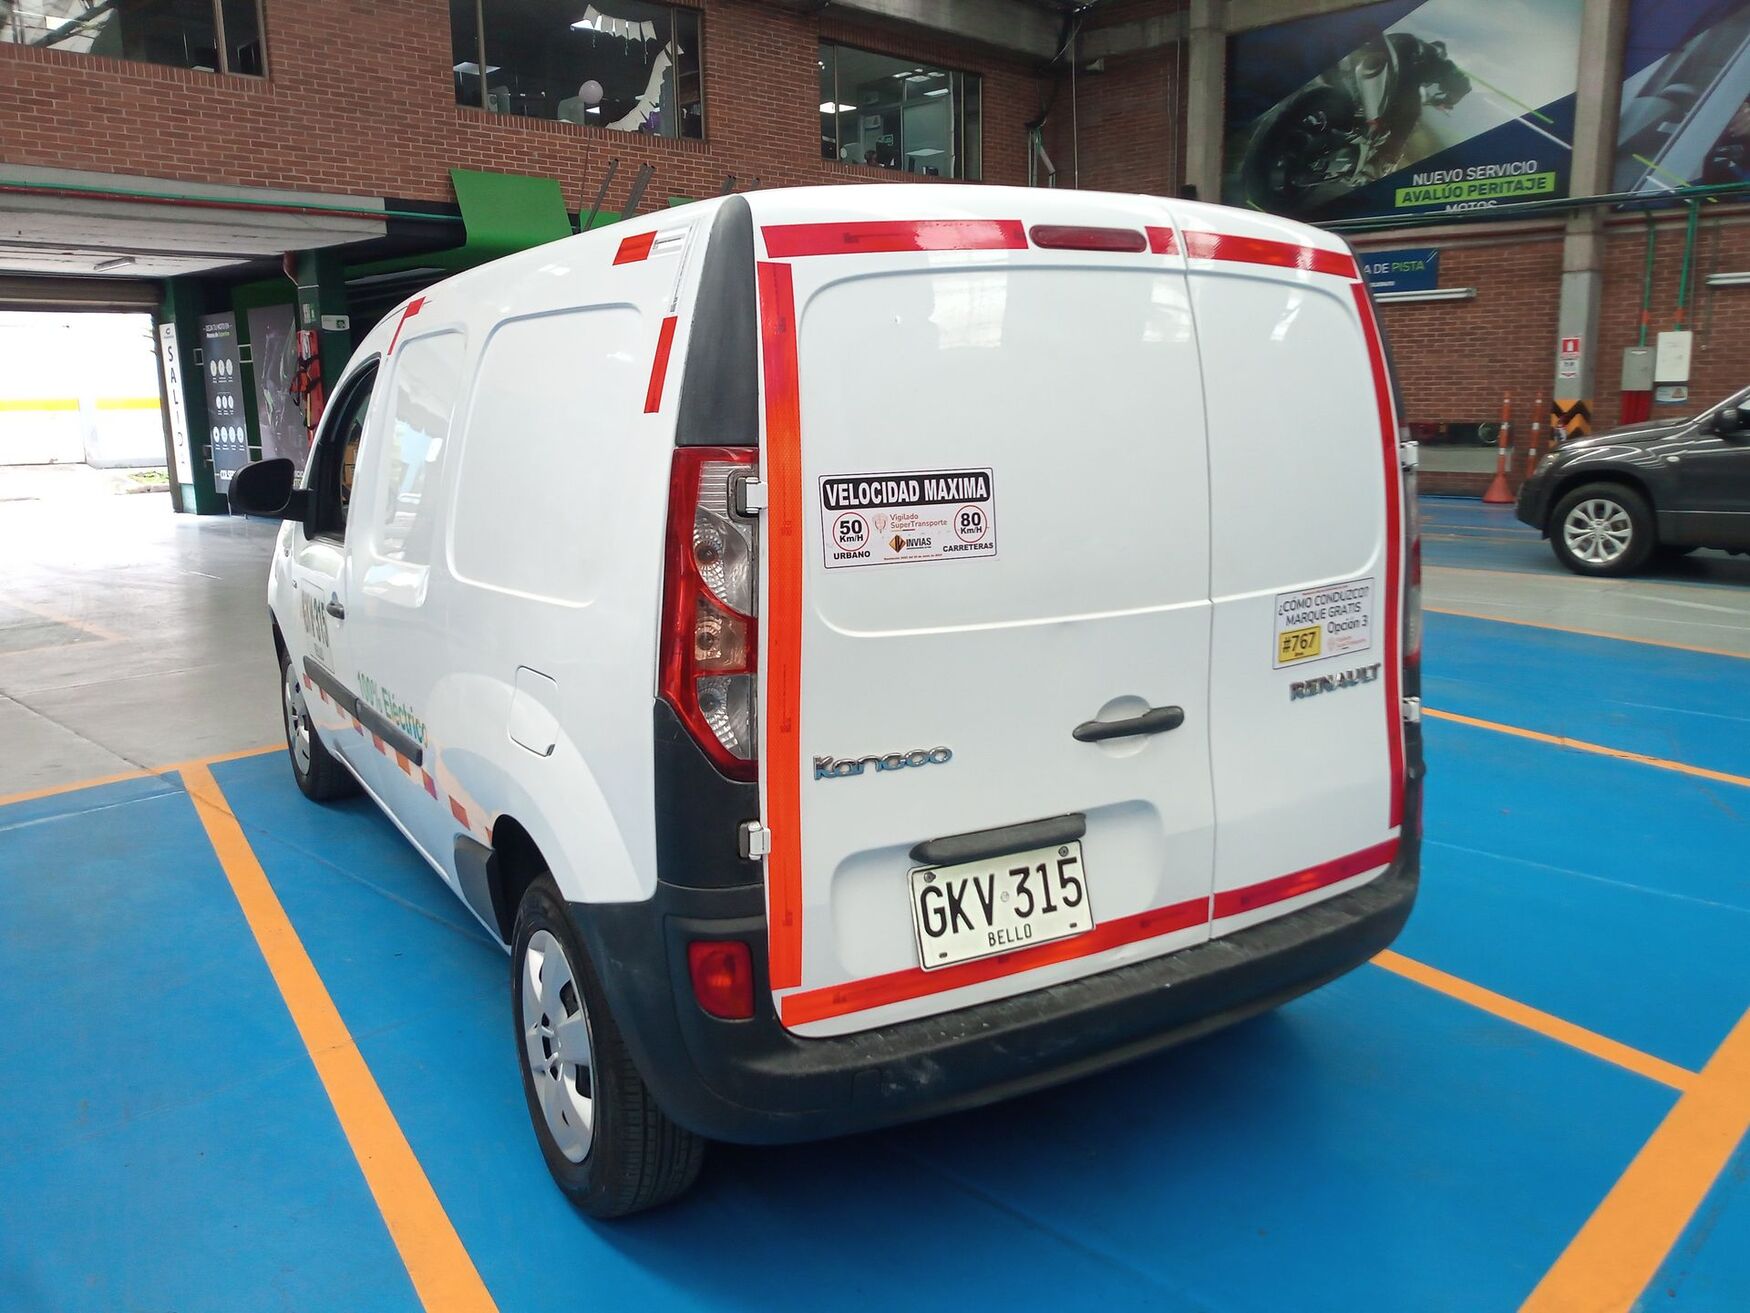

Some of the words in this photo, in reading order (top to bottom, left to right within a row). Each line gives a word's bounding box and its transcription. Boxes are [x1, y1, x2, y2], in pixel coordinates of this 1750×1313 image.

[1412, 168, 1463, 186] NUEVO
[1466, 160, 1538, 180] SERVICIO
[1402, 183, 1463, 203] AVALÚO
[1467, 177, 1547, 197] PERITAJE
[1373, 262, 1390, 274] DE
[1391, 260, 1425, 272] PISTA
[825, 479, 920, 507] VELOCIDAD
[924, 476, 988, 502] MAXIMA
[889, 513, 919, 522] Vigilado
[890, 520, 948, 529] SuperTransporte
[960, 512, 982, 527] 80
[839, 519, 863, 535] 50
[960, 525, 983, 535] Km/H
[839, 533, 864, 543] Km/H
[906, 537, 932, 547] INVIAS
[833, 550, 871, 560] URBANO
[942, 542, 994, 553] CARRETERAS
[1285, 608, 1327, 627] MARQUE
[1328, 601, 1362, 618] GRATIS
[1282, 631, 1317, 654] #767
[1289, 662, 1382, 702] RENAULT
[812, 745, 953, 781] Kangoo
[919, 872, 996, 939] GKV
[1008, 856, 1084, 920] 315
[987, 922, 1033, 948] BELLO
